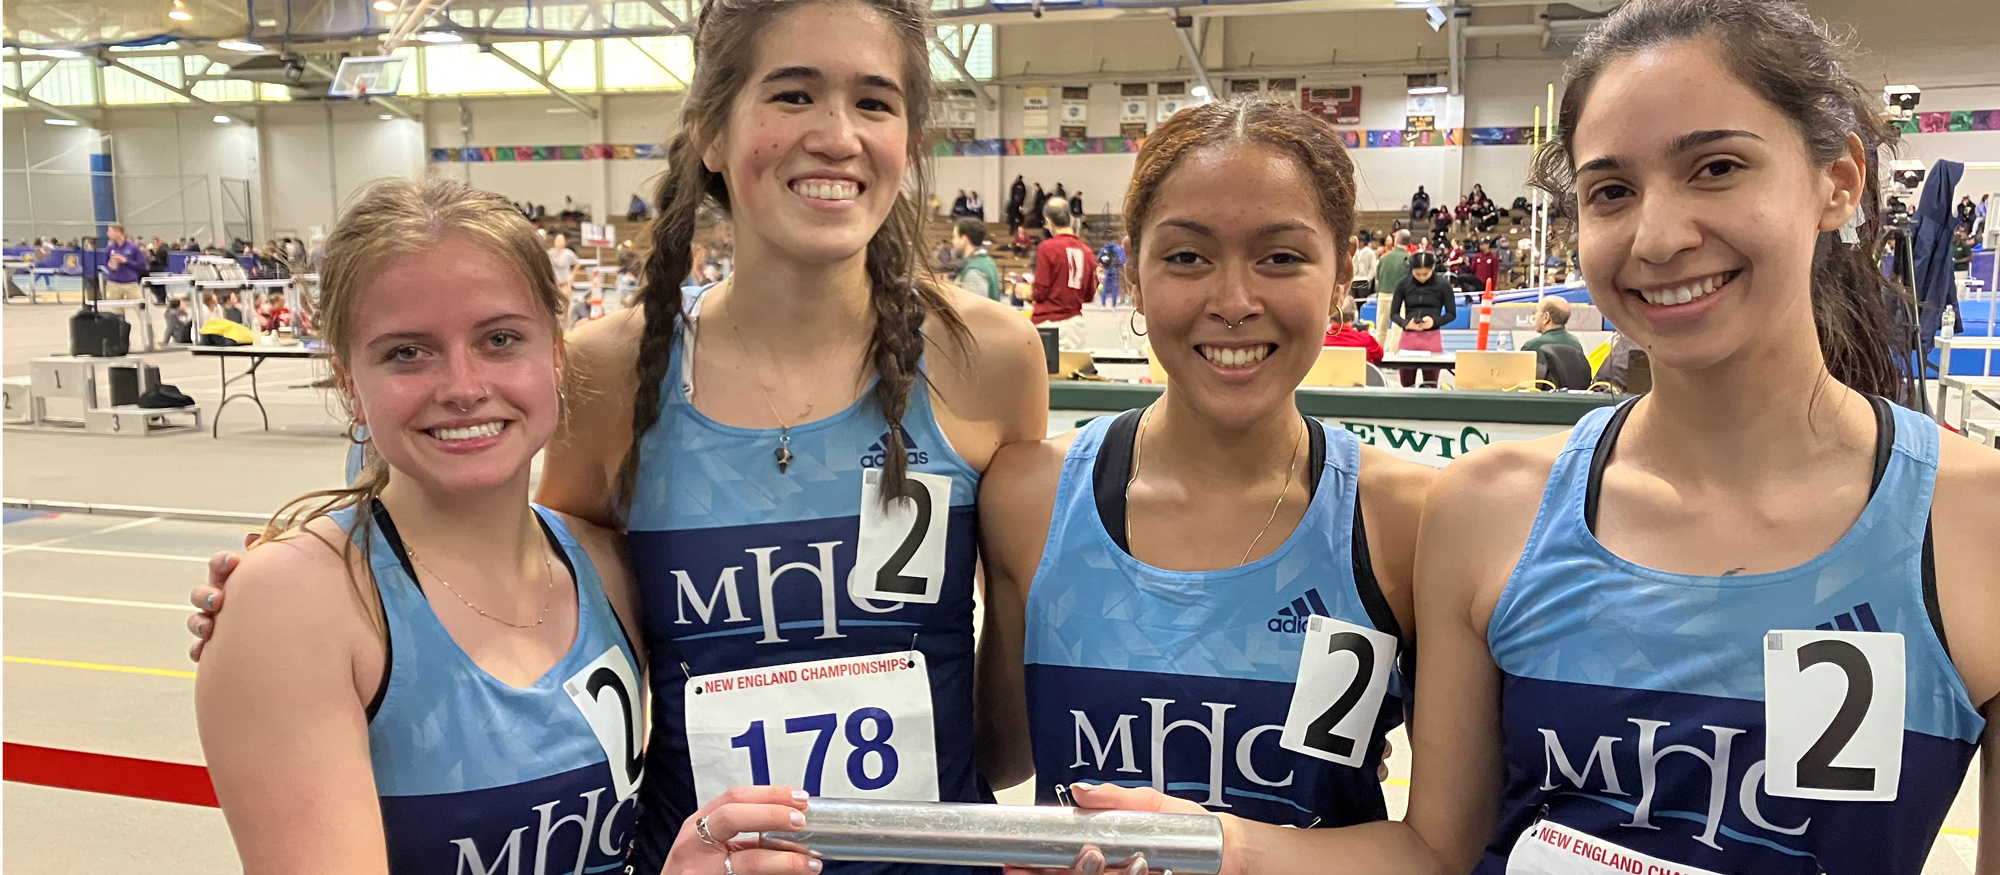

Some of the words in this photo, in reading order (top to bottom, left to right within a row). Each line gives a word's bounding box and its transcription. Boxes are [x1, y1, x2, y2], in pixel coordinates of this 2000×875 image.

[3, 391, 11, 409] 2
[54, 370, 61, 388] 1
[113, 414, 120, 431] 3
[1338, 421, 1490, 460] EWI
[860, 451, 929, 469] adas
[875, 478, 932, 595] 2
[704, 677, 734, 694] NEW
[737, 670, 797, 689] ENGLAND
[801, 657, 908, 681] CHAMPIONSHIPS
[1303, 631, 1375, 758] 2
[586, 667, 643, 785] 2
[1796, 639, 1876, 791] 2
[730, 706, 899, 797] 178
[1069, 697, 1294, 808] MHC
[1537, 717, 1811, 851] MHC
[1538, 827, 1573, 850] NEW
[1572, 840, 1643, 875] ENGLAND
